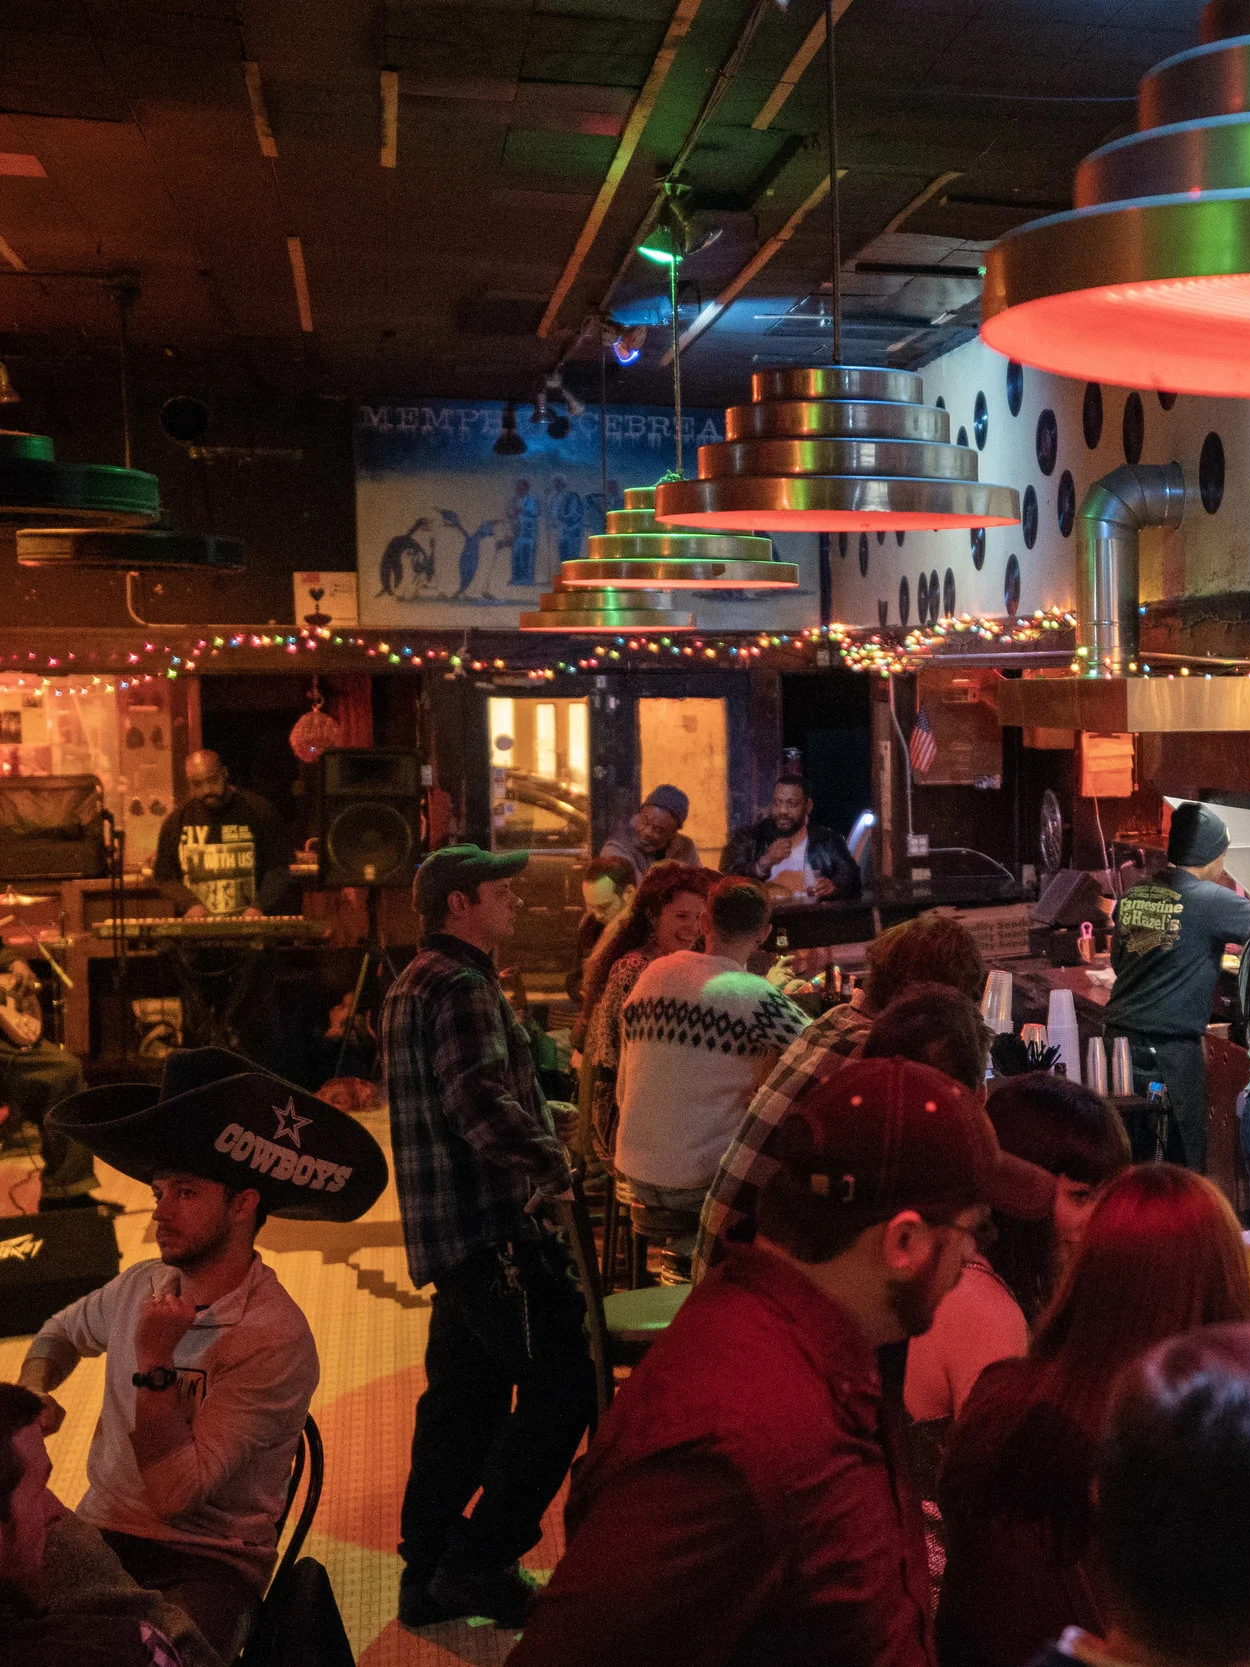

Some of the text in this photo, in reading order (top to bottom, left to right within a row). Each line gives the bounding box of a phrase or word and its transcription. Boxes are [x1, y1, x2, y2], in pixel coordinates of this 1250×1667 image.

[356, 405, 724, 442] MEMPH CEBREA
[214, 1123, 353, 1192] COWBOYS
